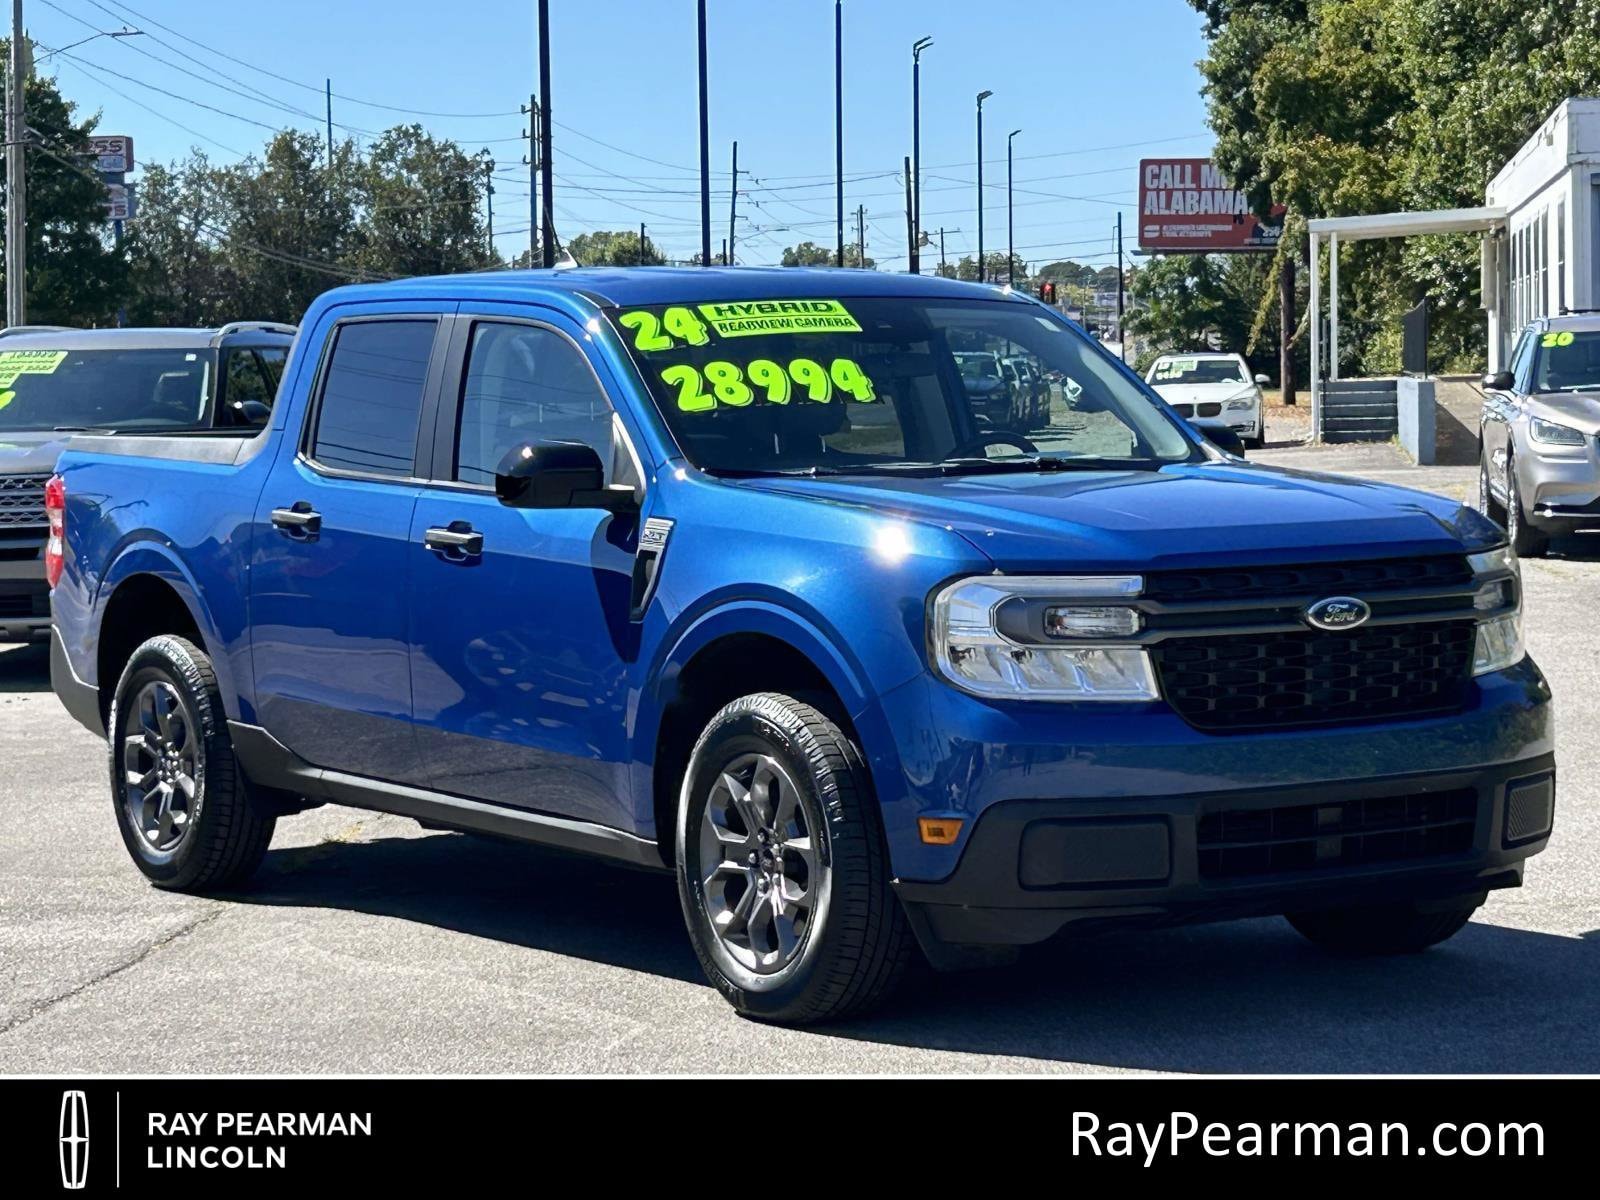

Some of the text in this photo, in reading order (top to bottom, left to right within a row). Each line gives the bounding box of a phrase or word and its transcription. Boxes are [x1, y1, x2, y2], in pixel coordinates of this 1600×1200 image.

[1145, 164, 1197, 189] CALL
[1144, 190, 1249, 215] ALABAMA
[713, 301, 837, 317] HYBRID
[619, 307, 710, 351] 24
[795, 316, 857, 328] CAMERA
[661, 358, 877, 412] 28994
[1323, 603, 1359, 623] Ford
